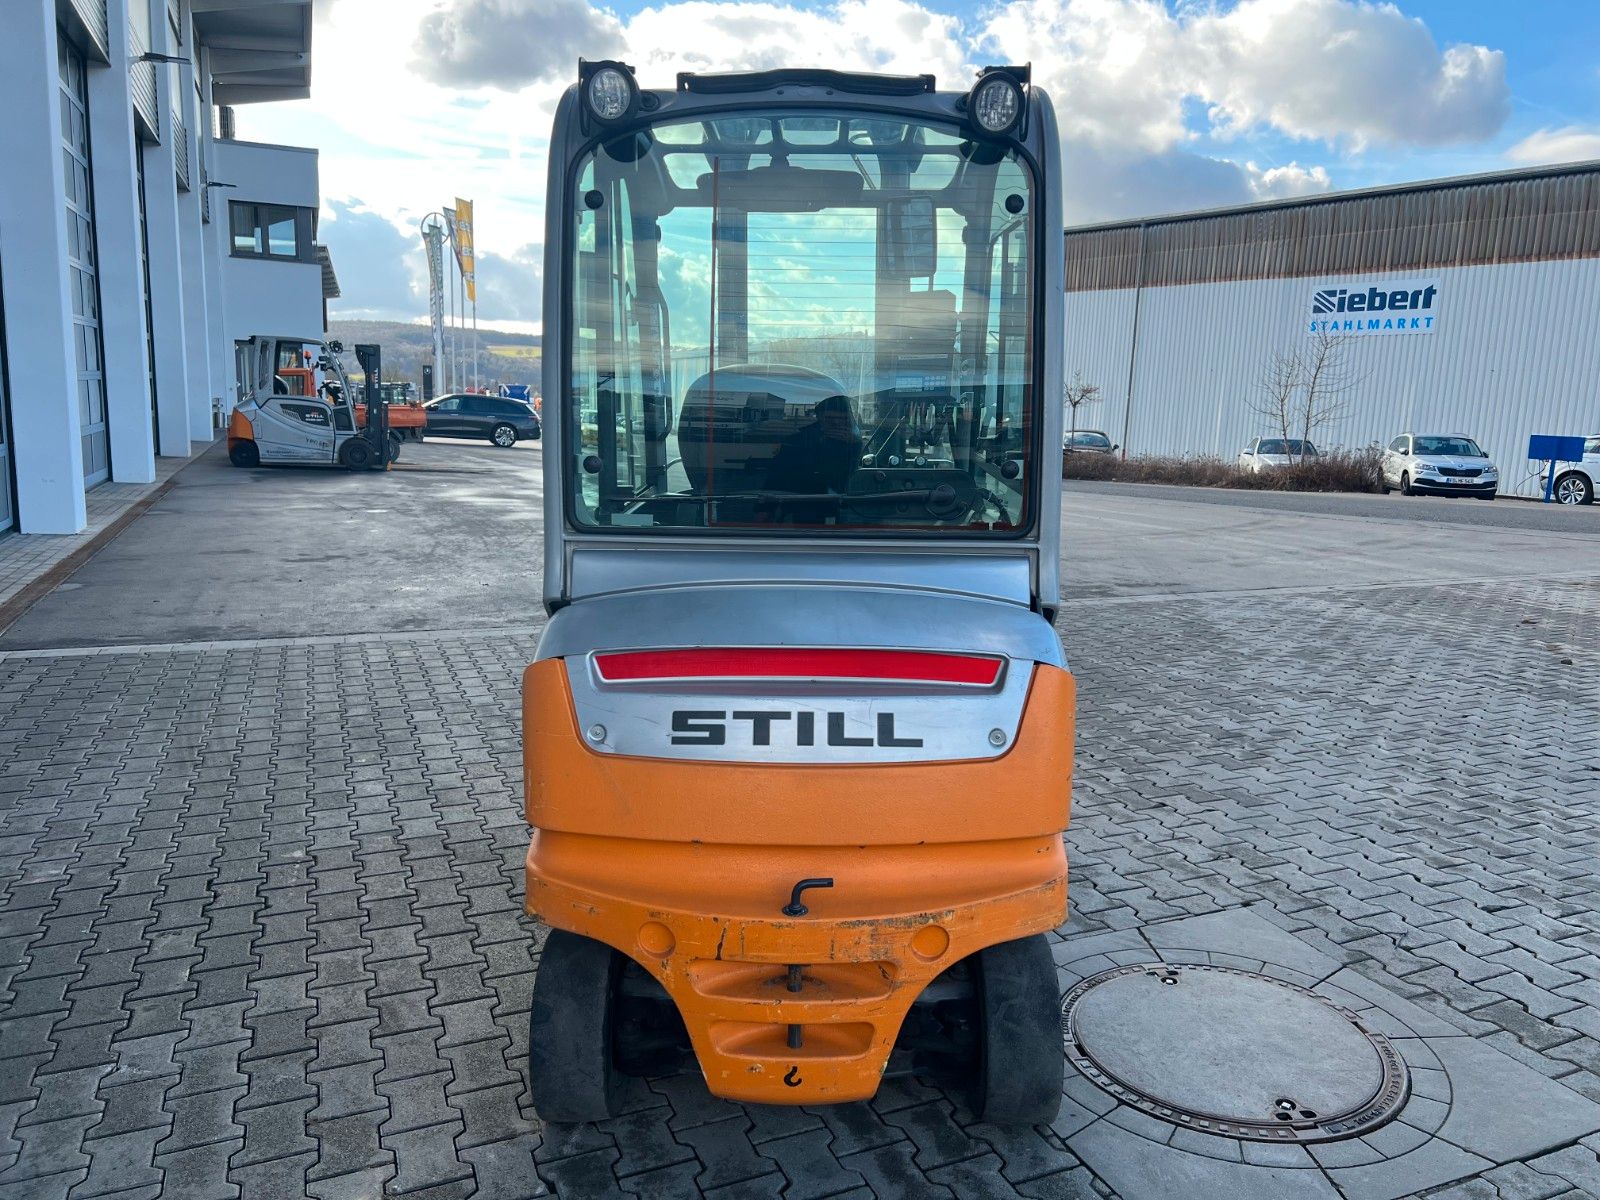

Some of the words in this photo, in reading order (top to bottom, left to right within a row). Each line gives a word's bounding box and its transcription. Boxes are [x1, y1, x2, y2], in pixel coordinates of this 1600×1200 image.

[1312, 284, 1437, 313] Siebert
[1310, 317, 1433, 331] STAHLMARKT
[671, 710, 923, 748] STILL
